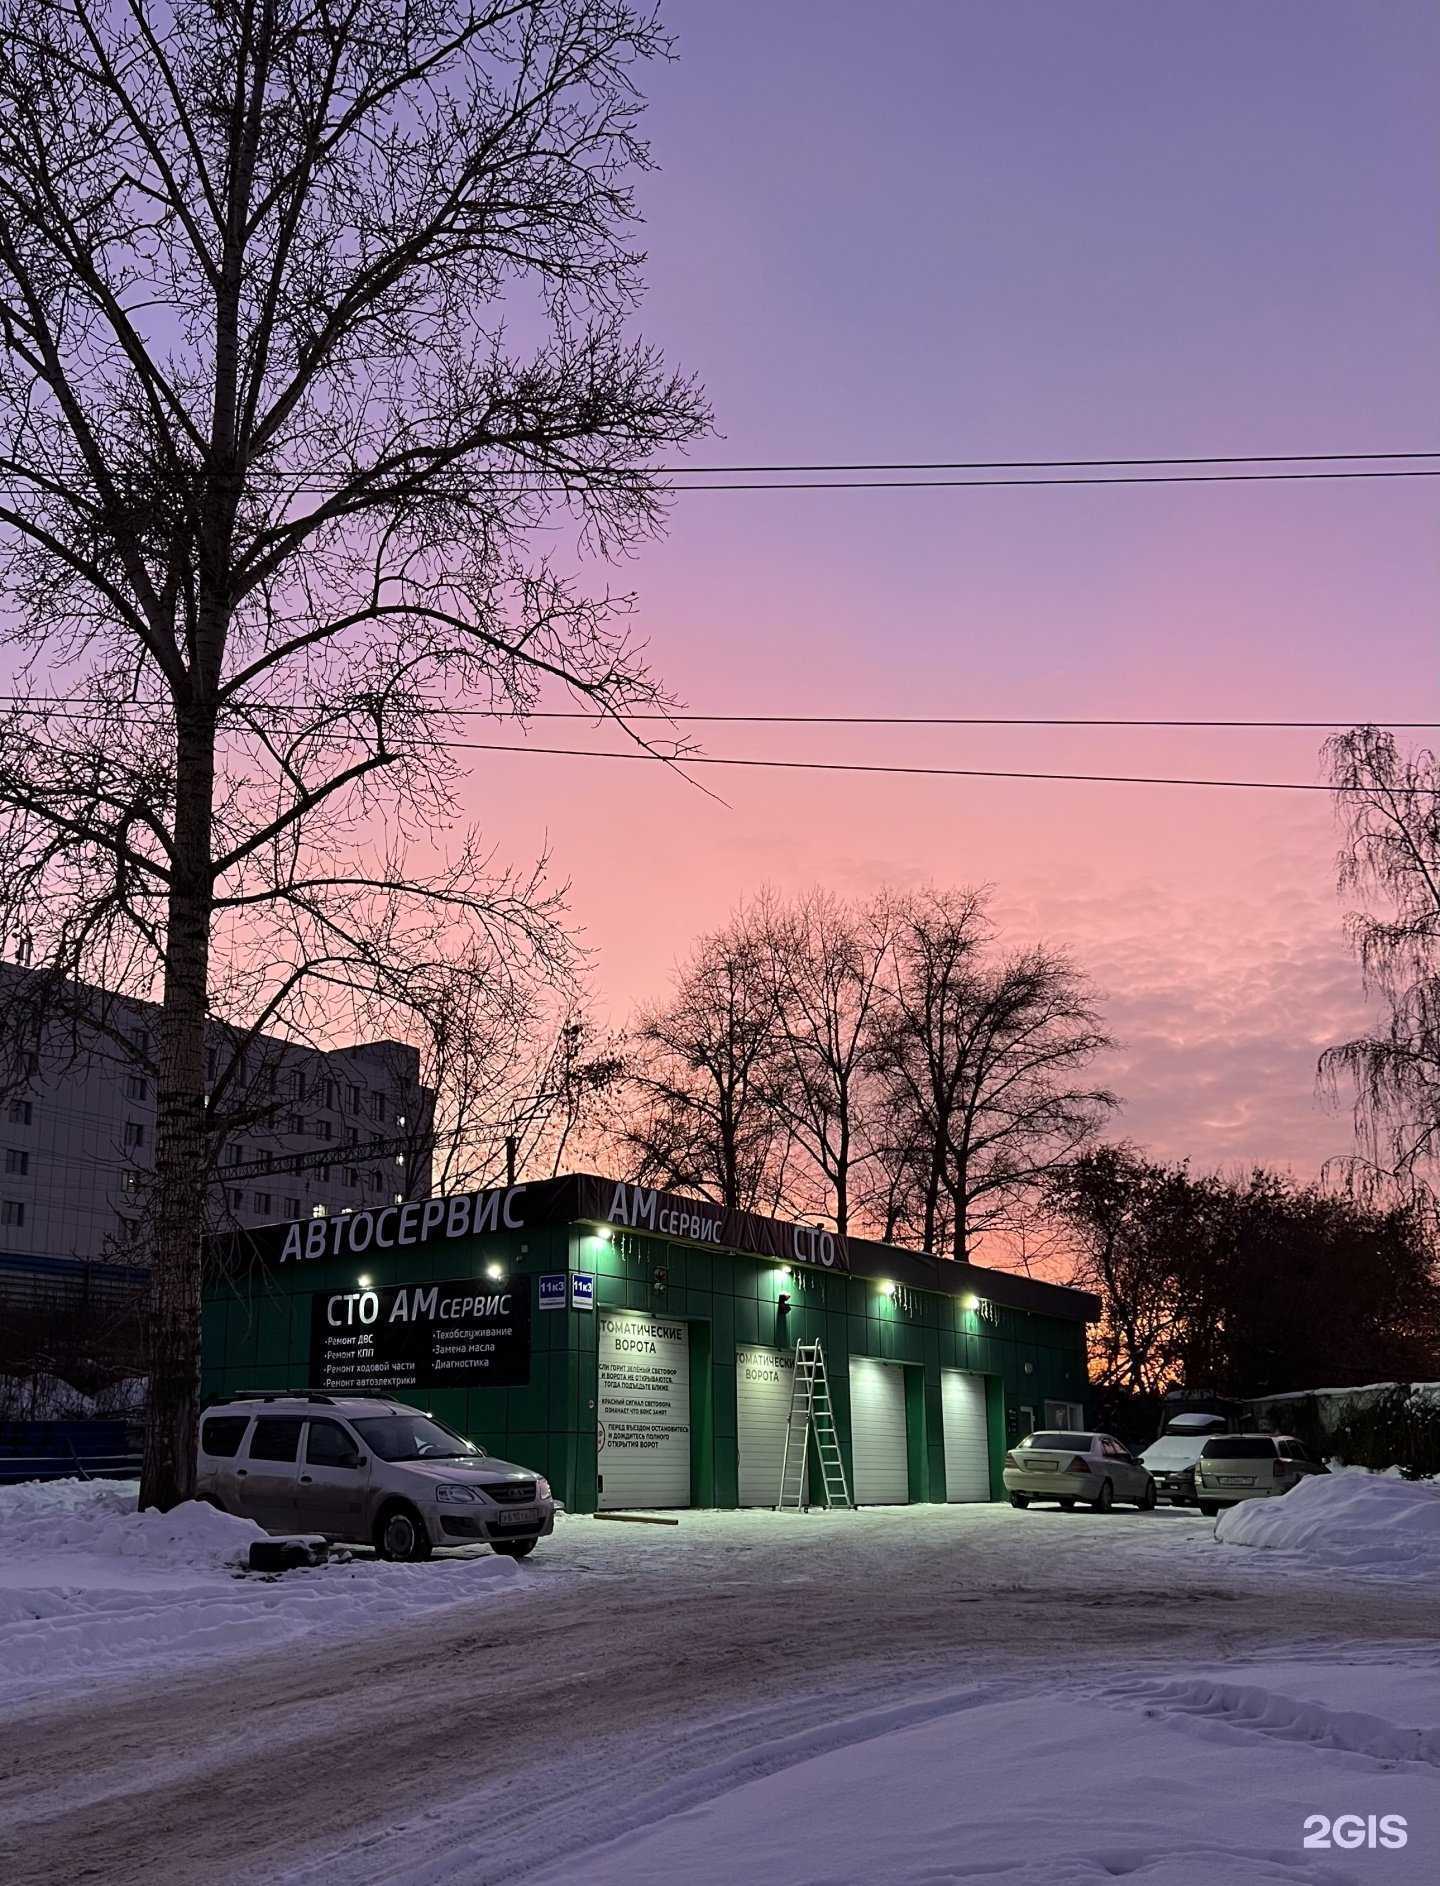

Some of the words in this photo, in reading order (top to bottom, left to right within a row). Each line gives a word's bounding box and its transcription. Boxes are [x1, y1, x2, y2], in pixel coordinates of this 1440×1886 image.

[608, 1183, 657, 1231] АМ
[659, 1208, 722, 1244] СЕРВИС
[280, 1186, 526, 1264] АВТОСЕРВИС
[793, 1226, 834, 1267] СТО
[541, 1281, 564, 1293] 11к3
[573, 1280, 592, 1293] 11к3
[327, 1291, 379, 1327] СТО
[388, 1287, 439, 1323] АМ
[440, 1294, 512, 1319] СЕРВИС
[327, 1336, 356, 1345] Ремонт
[357, 1334, 374, 1345] ДВС
[436, 1327, 513, 1341] Техобслуживание
[468, 1343, 495, 1353] масла
[615, 1338, 657, 1354] ВОРОТА
[327, 1350, 356, 1359] Ремонт
[357, 1348, 375, 1359] КПП
[326, 1364, 355, 1374] Ремонт
[356, 1361, 390, 1373] ходовой
[391, 1362, 416, 1371] части
[434, 1359, 490, 1370] Диагностика
[745, 1368, 781, 1382] ВОРОТА
[608, 1423, 626, 1432] ПЕРЕД
[640, 1441, 660, 1449] ВОРОТ
